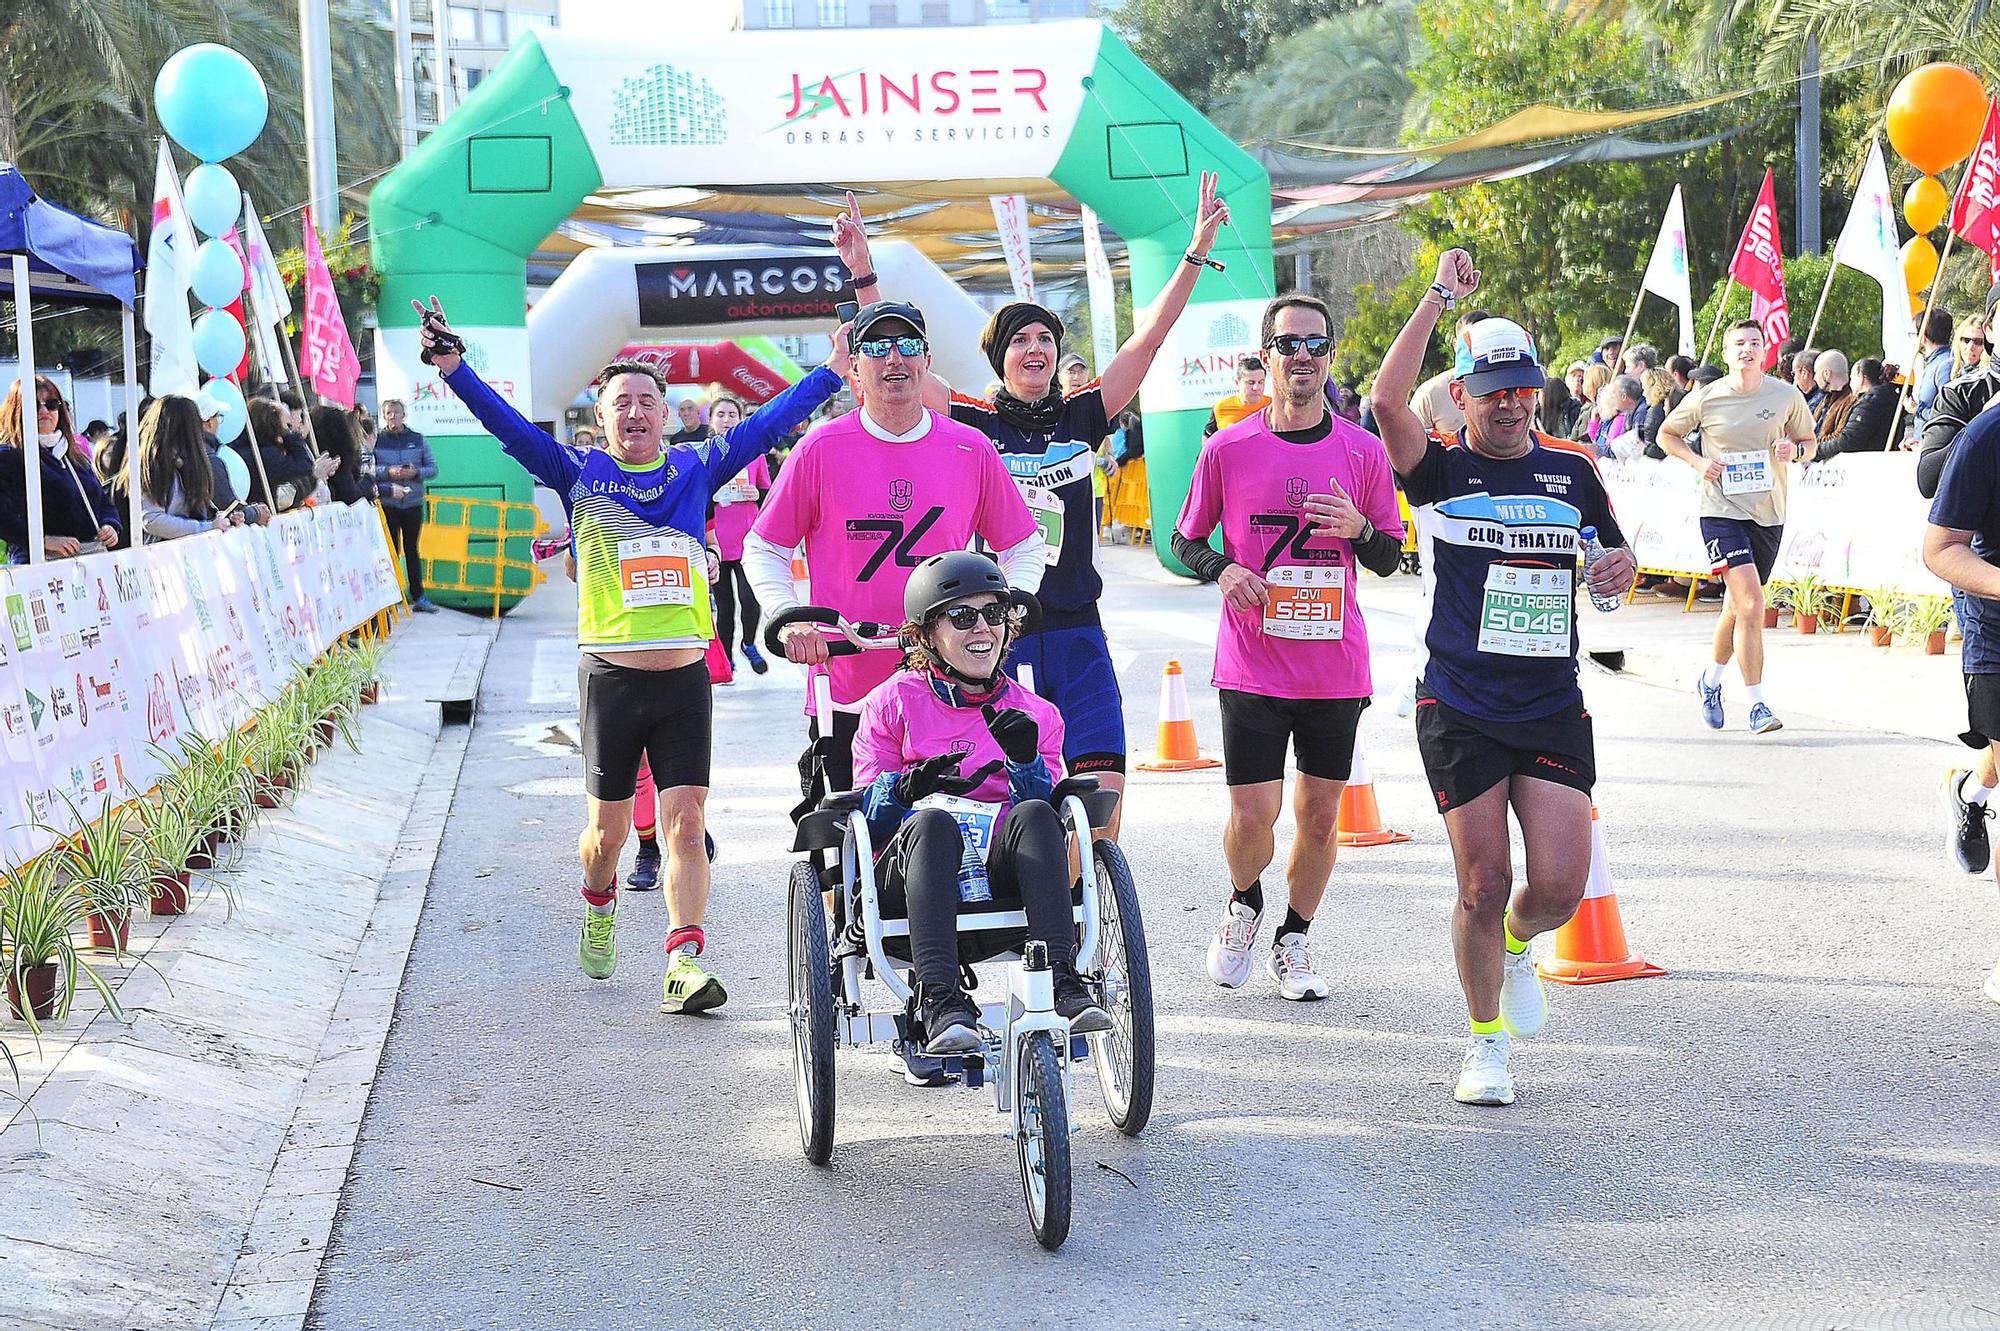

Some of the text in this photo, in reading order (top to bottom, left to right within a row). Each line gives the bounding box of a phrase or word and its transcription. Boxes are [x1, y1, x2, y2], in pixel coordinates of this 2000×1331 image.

[785, 68, 1049, 119] JAINSER
[786, 125, 1052, 145] OBRAS Y SERVICIOS
[668, 264, 844, 300] MARCOS
[1467, 477, 1483, 485] VIA
[1533, 472, 1572, 485] TRAVESIAS
[1728, 470, 1765, 483] 1845
[1545, 483, 1568, 495] MITOS
[1494, 503, 1547, 520] MITOS
[1467, 526, 1575, 550] CLUB TRIATLON
[631, 568, 684, 590] 5391
[1291, 588, 1321, 601] JOVI
[1488, 590, 1568, 610] TITO ROBER
[1275, 601, 1333, 621] 5231
[1487, 608, 1566, 634] 5046
